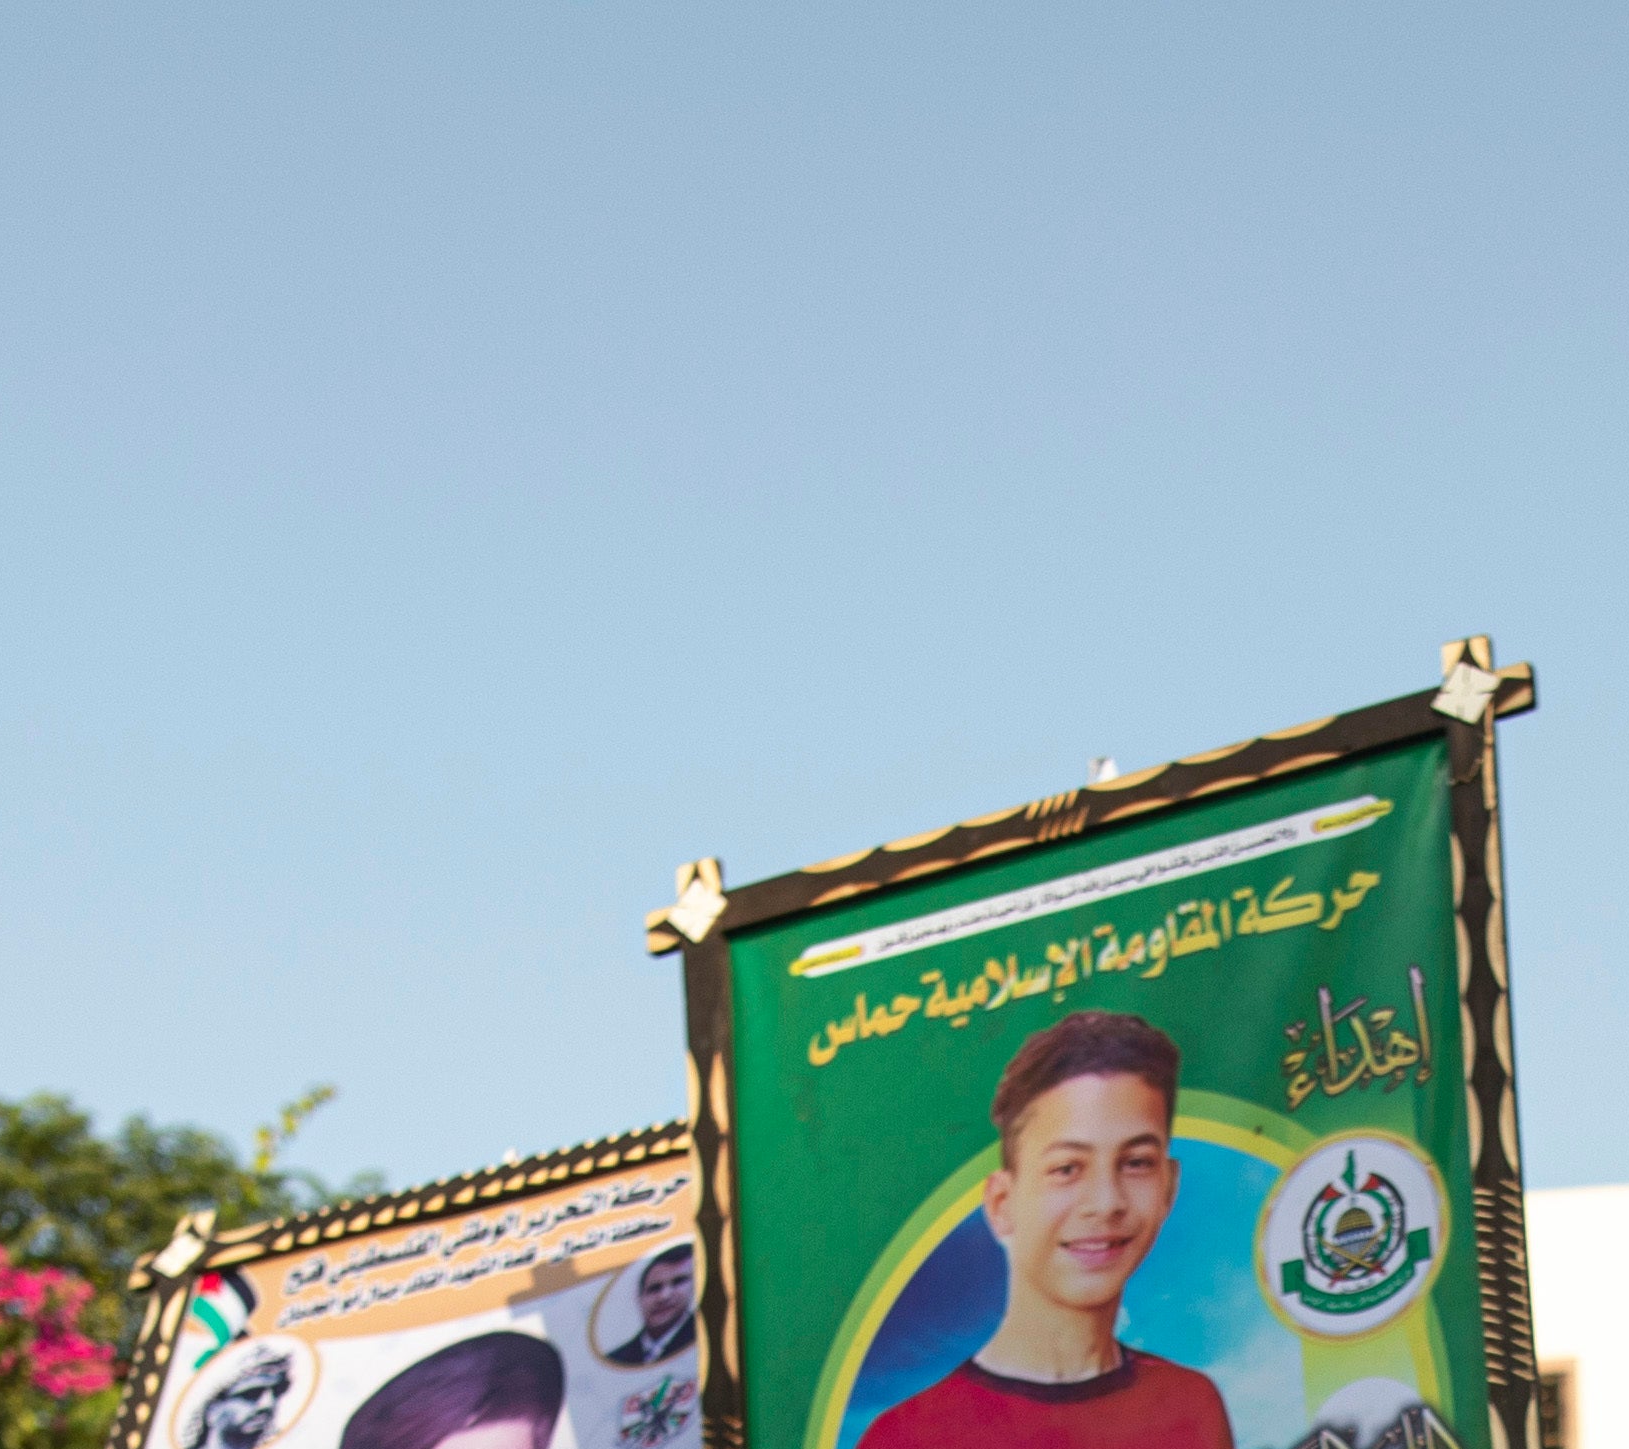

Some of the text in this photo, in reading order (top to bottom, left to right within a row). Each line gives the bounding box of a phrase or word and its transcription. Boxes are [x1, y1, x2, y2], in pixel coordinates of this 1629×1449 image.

[1095, 900, 1231, 981] المقاومة
[1237, 869, 1381, 937] حركة
[920, 938, 1093, 1029] الإسلامية
[807, 993, 923, 1067] حماس
